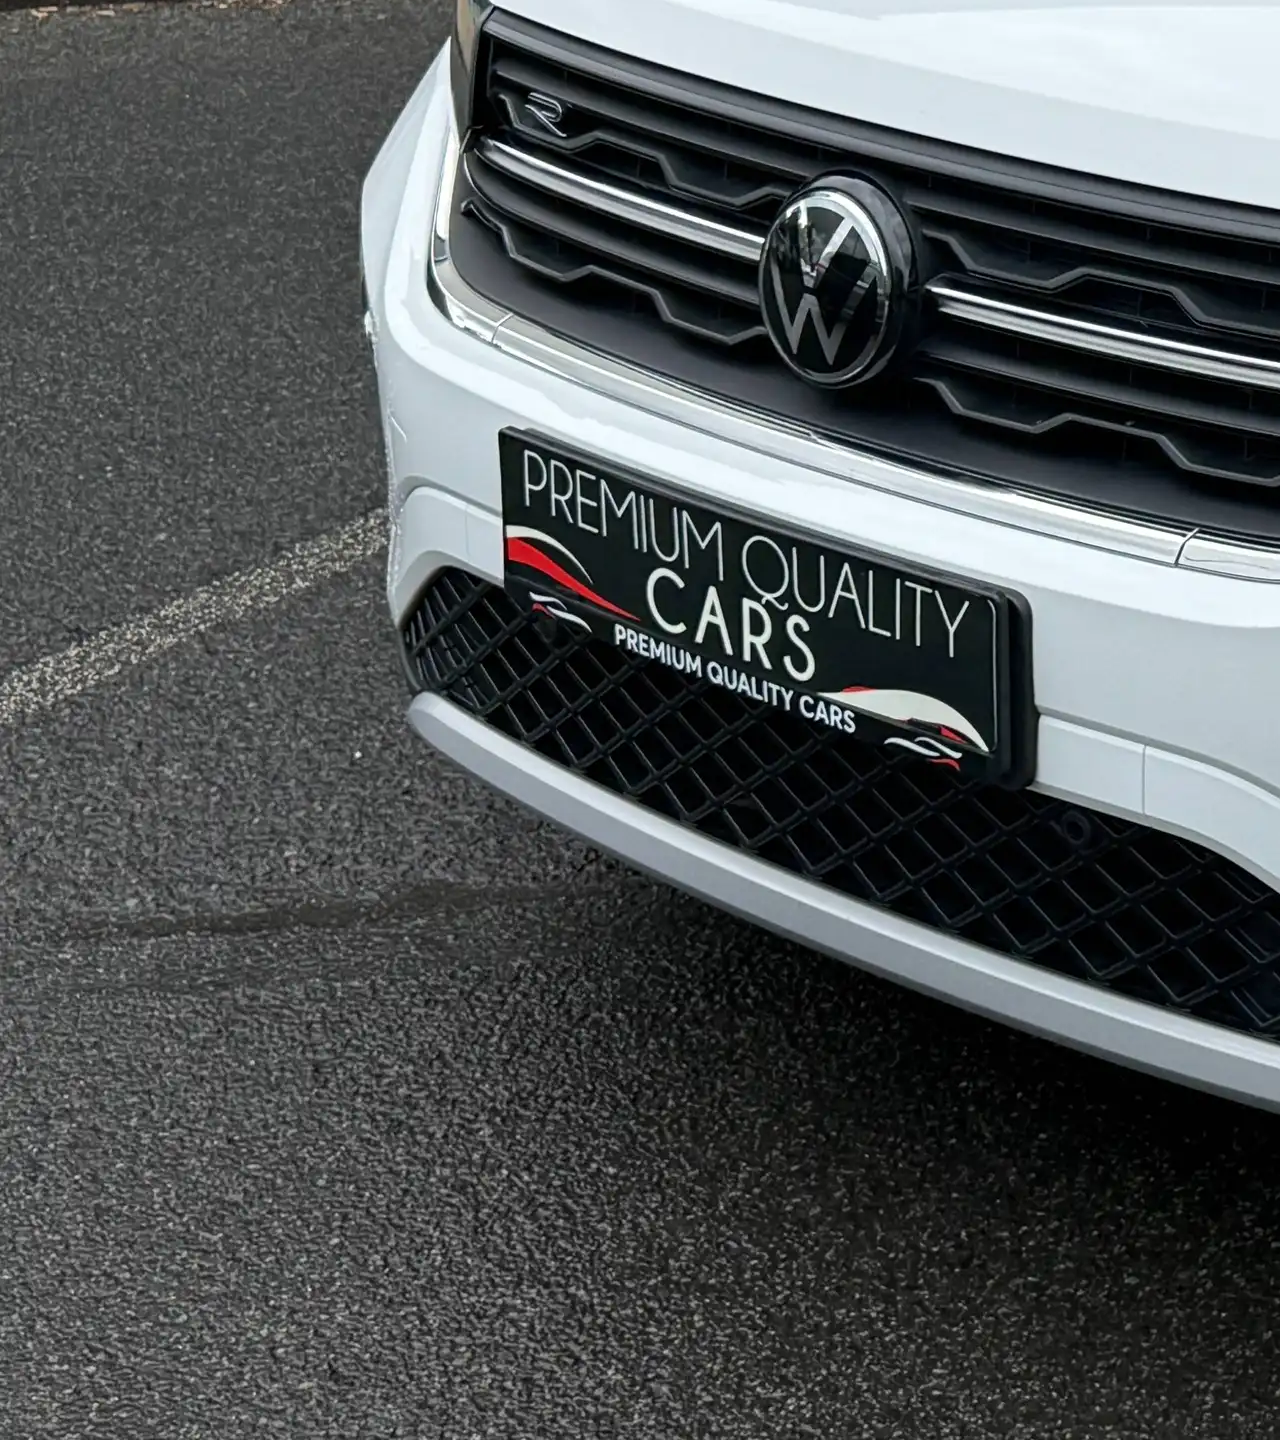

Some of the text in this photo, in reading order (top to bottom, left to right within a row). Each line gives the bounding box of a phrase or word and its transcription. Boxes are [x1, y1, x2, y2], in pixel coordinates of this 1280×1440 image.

[521, 448, 971, 659] PREMIUM QUALITY
[613, 622, 857, 736] PREMIUM QUALITY CARS
[645, 566, 817, 684] CARS
